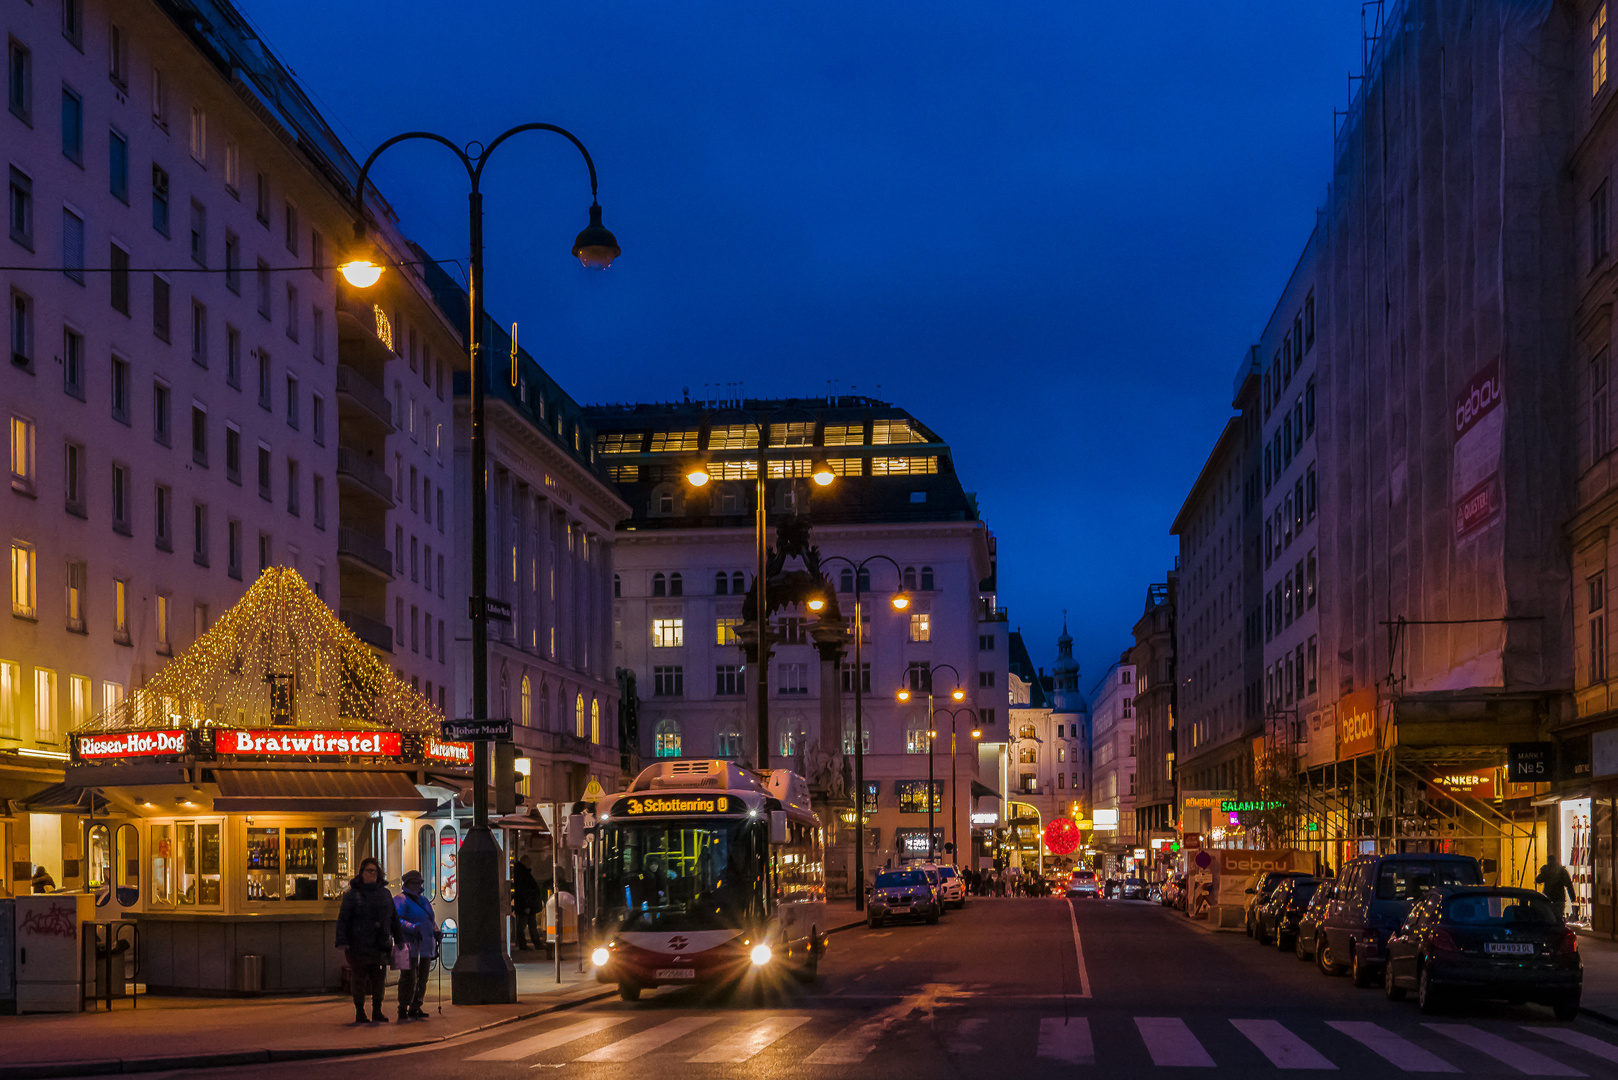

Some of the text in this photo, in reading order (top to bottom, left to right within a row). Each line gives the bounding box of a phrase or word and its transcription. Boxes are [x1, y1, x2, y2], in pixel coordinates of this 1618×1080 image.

[1455, 376, 1500, 432] bebau
[481, 725, 508, 735] Markt
[1342, 706, 1375, 745] bebau
[80, 732, 185, 754] Riesen-Hot-Dog
[236, 731, 381, 753] Bratwürstel
[1518, 752, 1544, 760] MARKT
[1443, 775, 1480, 785] ANKER
[643, 799, 714, 813] Schottenring
[1225, 857, 1287, 871] bebau
